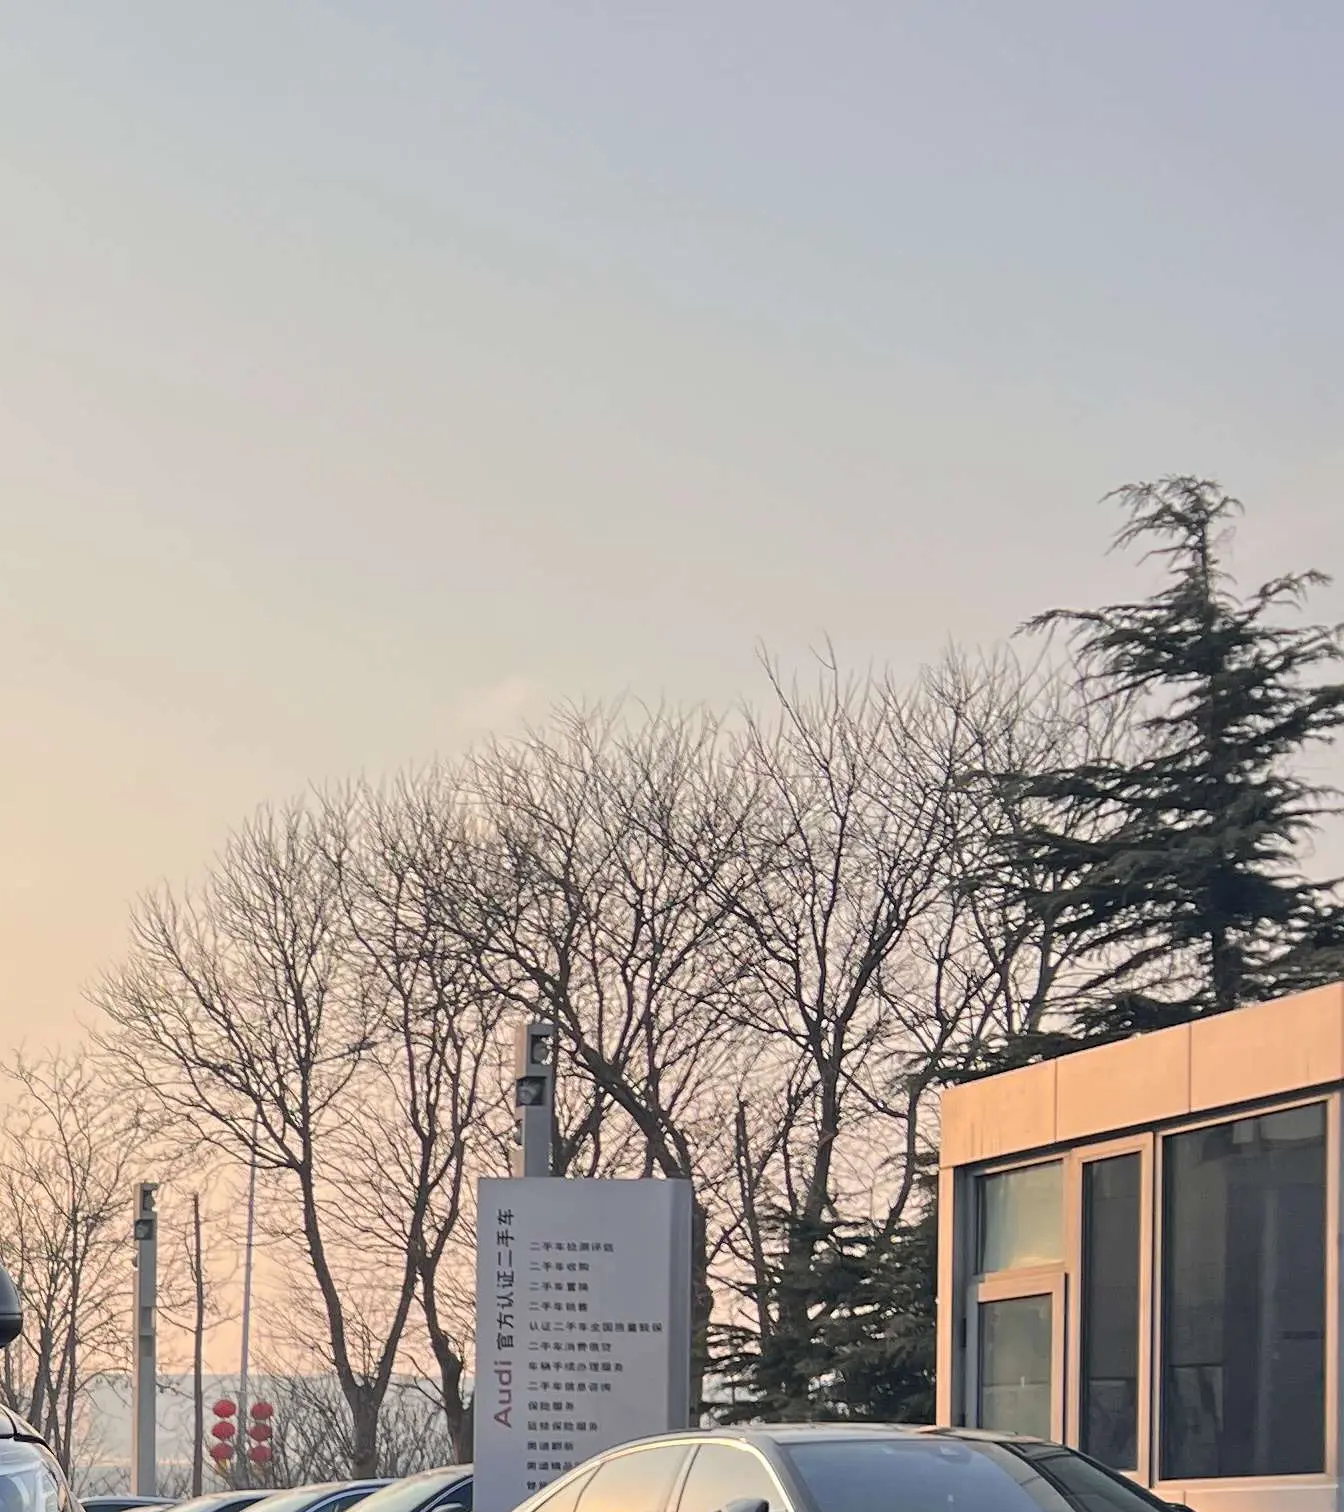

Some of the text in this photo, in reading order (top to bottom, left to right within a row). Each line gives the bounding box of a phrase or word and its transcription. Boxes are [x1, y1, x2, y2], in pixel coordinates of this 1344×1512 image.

[494, 1208, 515, 1429] Audi 官方认证二手车
